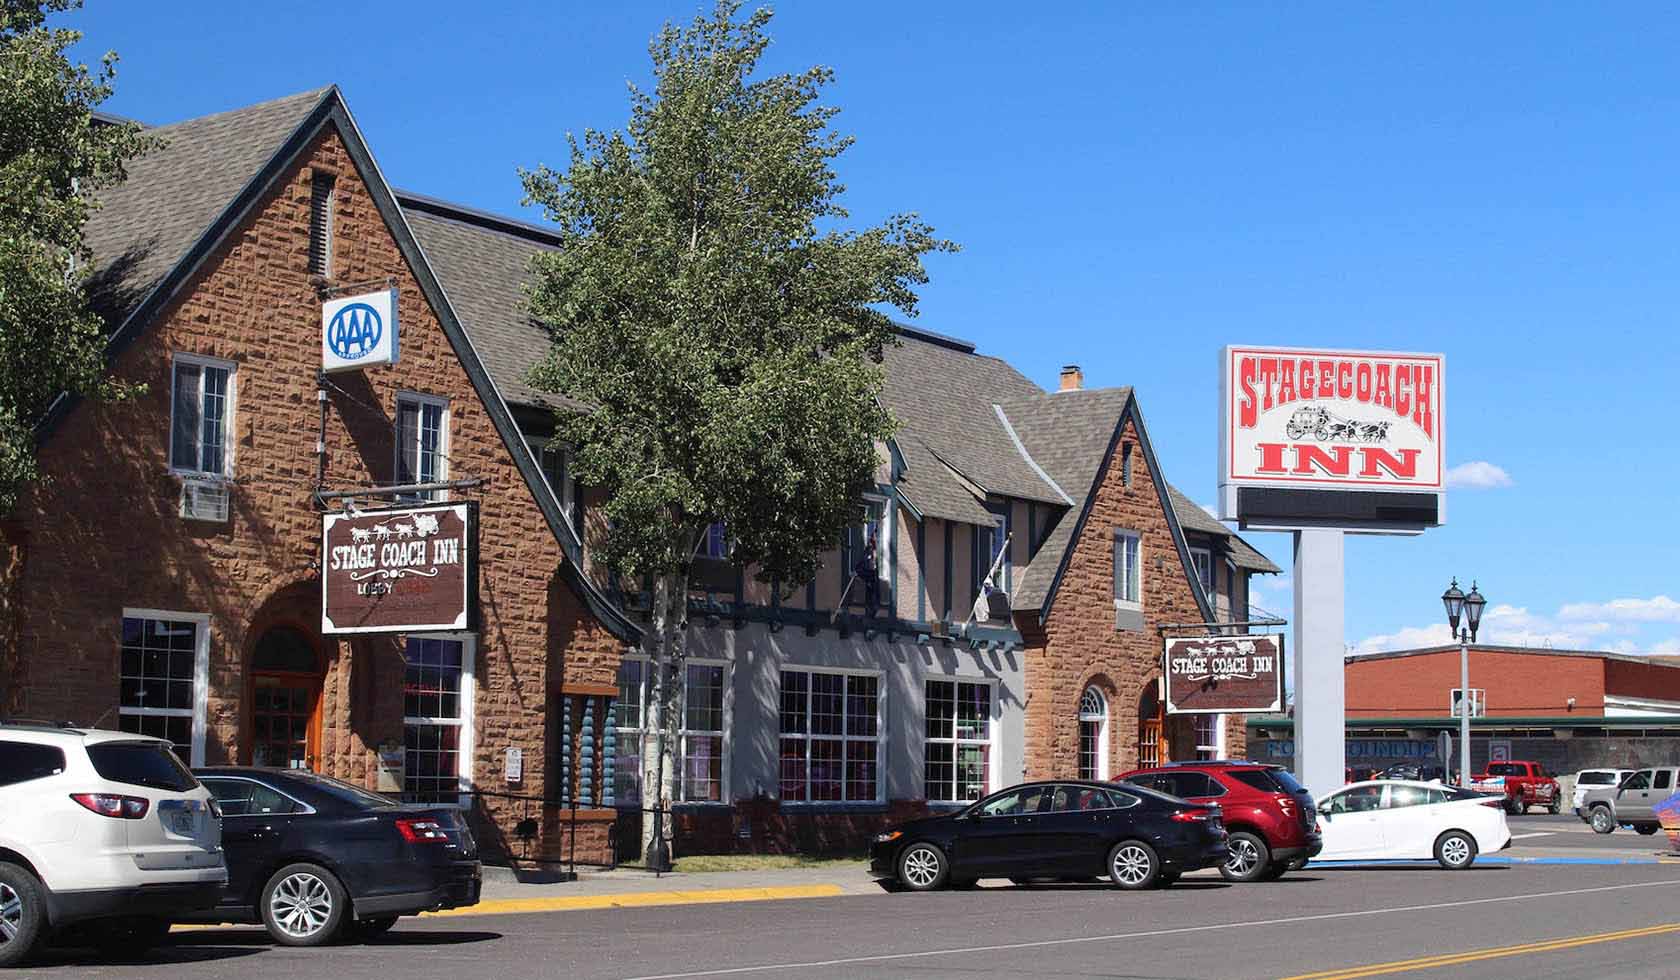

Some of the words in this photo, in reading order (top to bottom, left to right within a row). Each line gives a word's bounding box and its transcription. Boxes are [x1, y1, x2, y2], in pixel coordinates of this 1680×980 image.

[335, 308, 375, 354] AAA
[1239, 357, 1433, 442] STAGECOACH
[1255, 443, 1422, 479] INN
[331, 543, 376, 570] STAGE
[381, 540, 426, 567] COACH
[433, 538, 459, 564] INN
[357, 581, 393, 595] LOBBY
[1171, 657, 1208, 674] STAGE
[1211, 657, 1248, 673] COACH
[1252, 656, 1273, 673] INN
